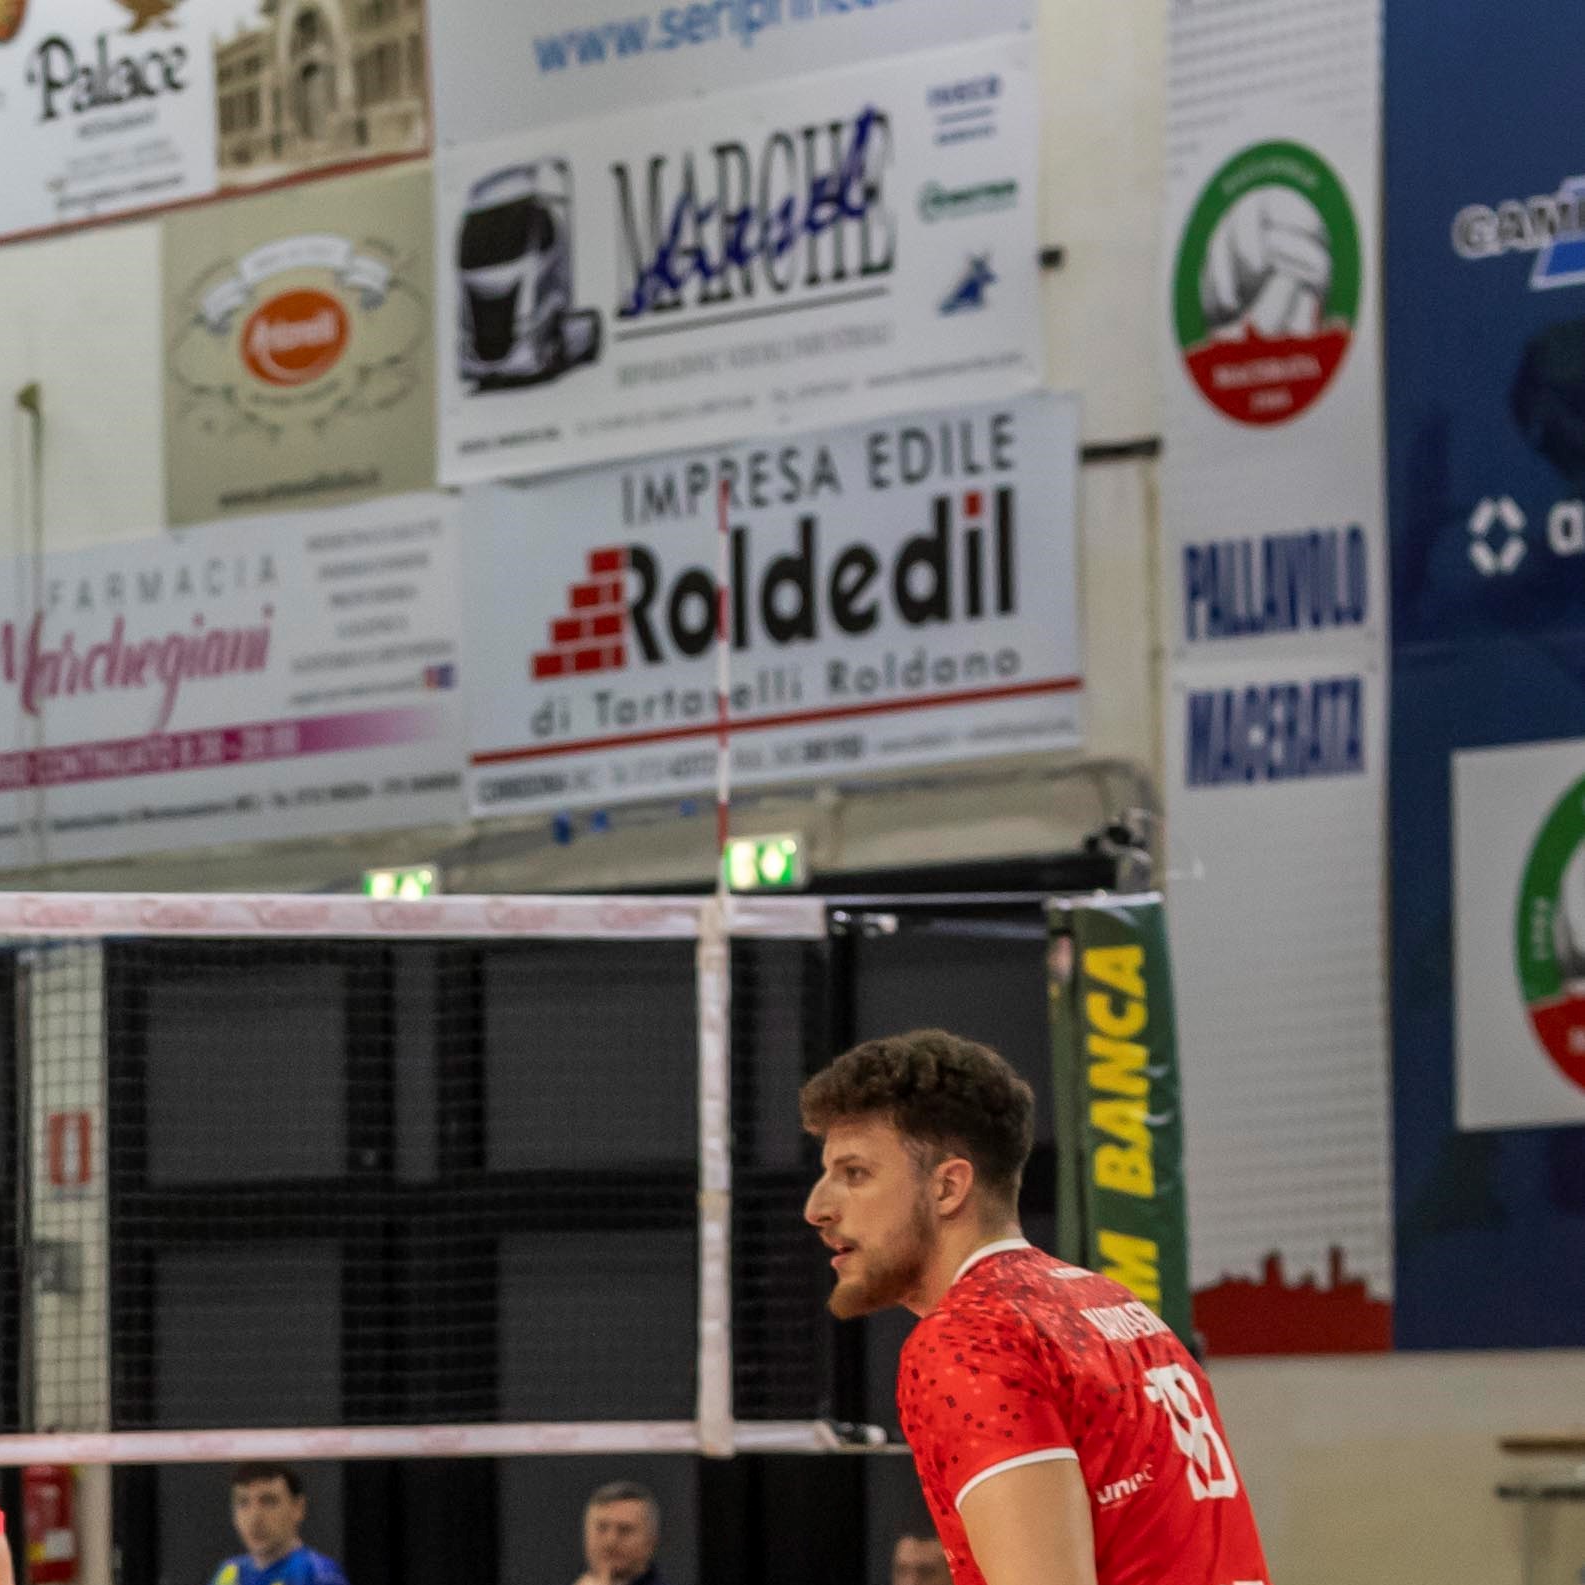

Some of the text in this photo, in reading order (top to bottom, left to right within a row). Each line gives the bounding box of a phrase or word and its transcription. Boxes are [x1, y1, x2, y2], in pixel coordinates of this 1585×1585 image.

[621, 415, 1015, 525] IMPRESA EDILE
[49, 554, 279, 611] FARMACIA
[627, 486, 1015, 664] Roldedil
[531, 646, 1020, 739] di Roldano
[1082, 944, 1155, 1199] BANCA
